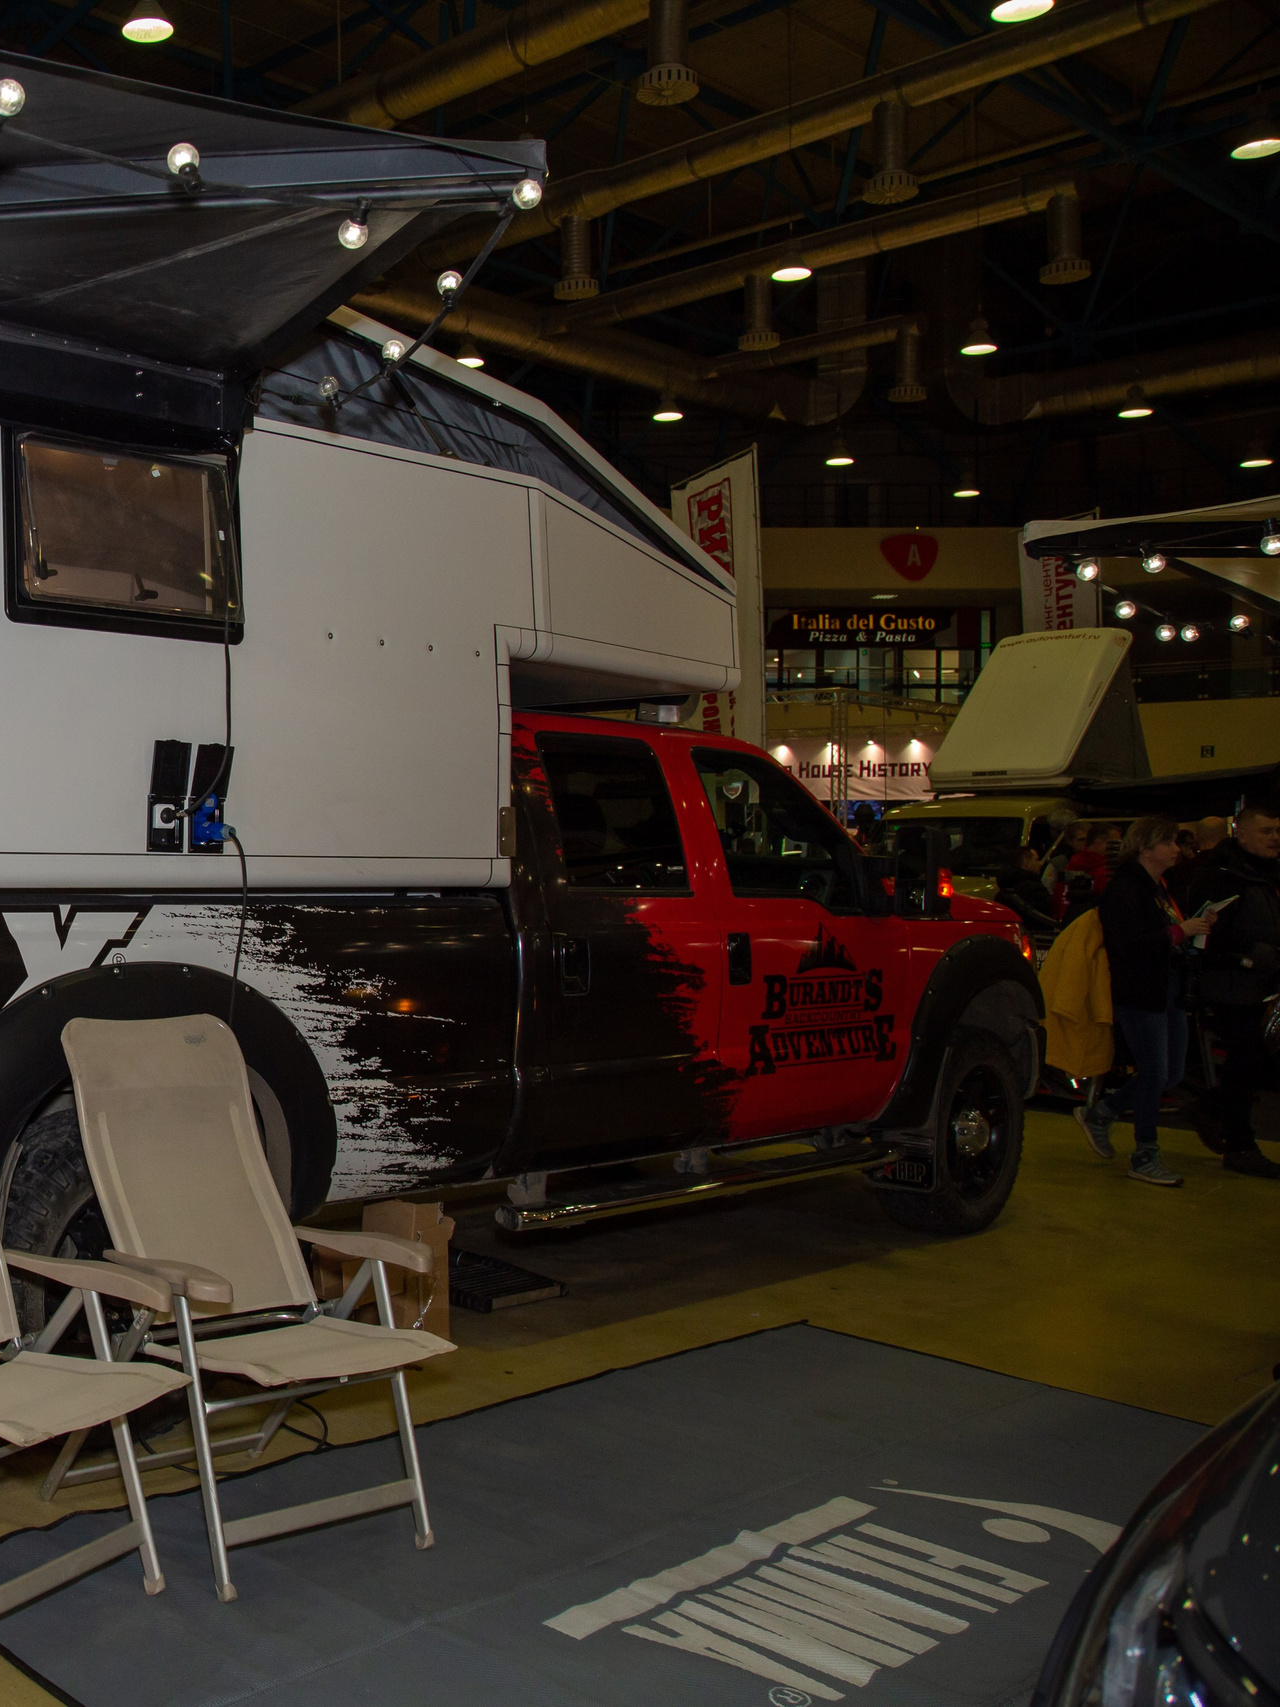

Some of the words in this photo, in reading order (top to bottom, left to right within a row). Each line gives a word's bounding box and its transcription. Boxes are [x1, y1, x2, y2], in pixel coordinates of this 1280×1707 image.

[792, 613, 841, 630] Italia
[846, 613, 874, 630] del
[879, 613, 935, 631] Gusto
[808, 631, 848, 642] Pizza
[856, 631, 867, 642] &
[875, 631, 916, 643] Pasta
[859, 760, 933, 778] HISTORY
[745, 1014, 897, 1077] ADVENTURE
[621, 1522, 1050, 1702] FIAMMA
